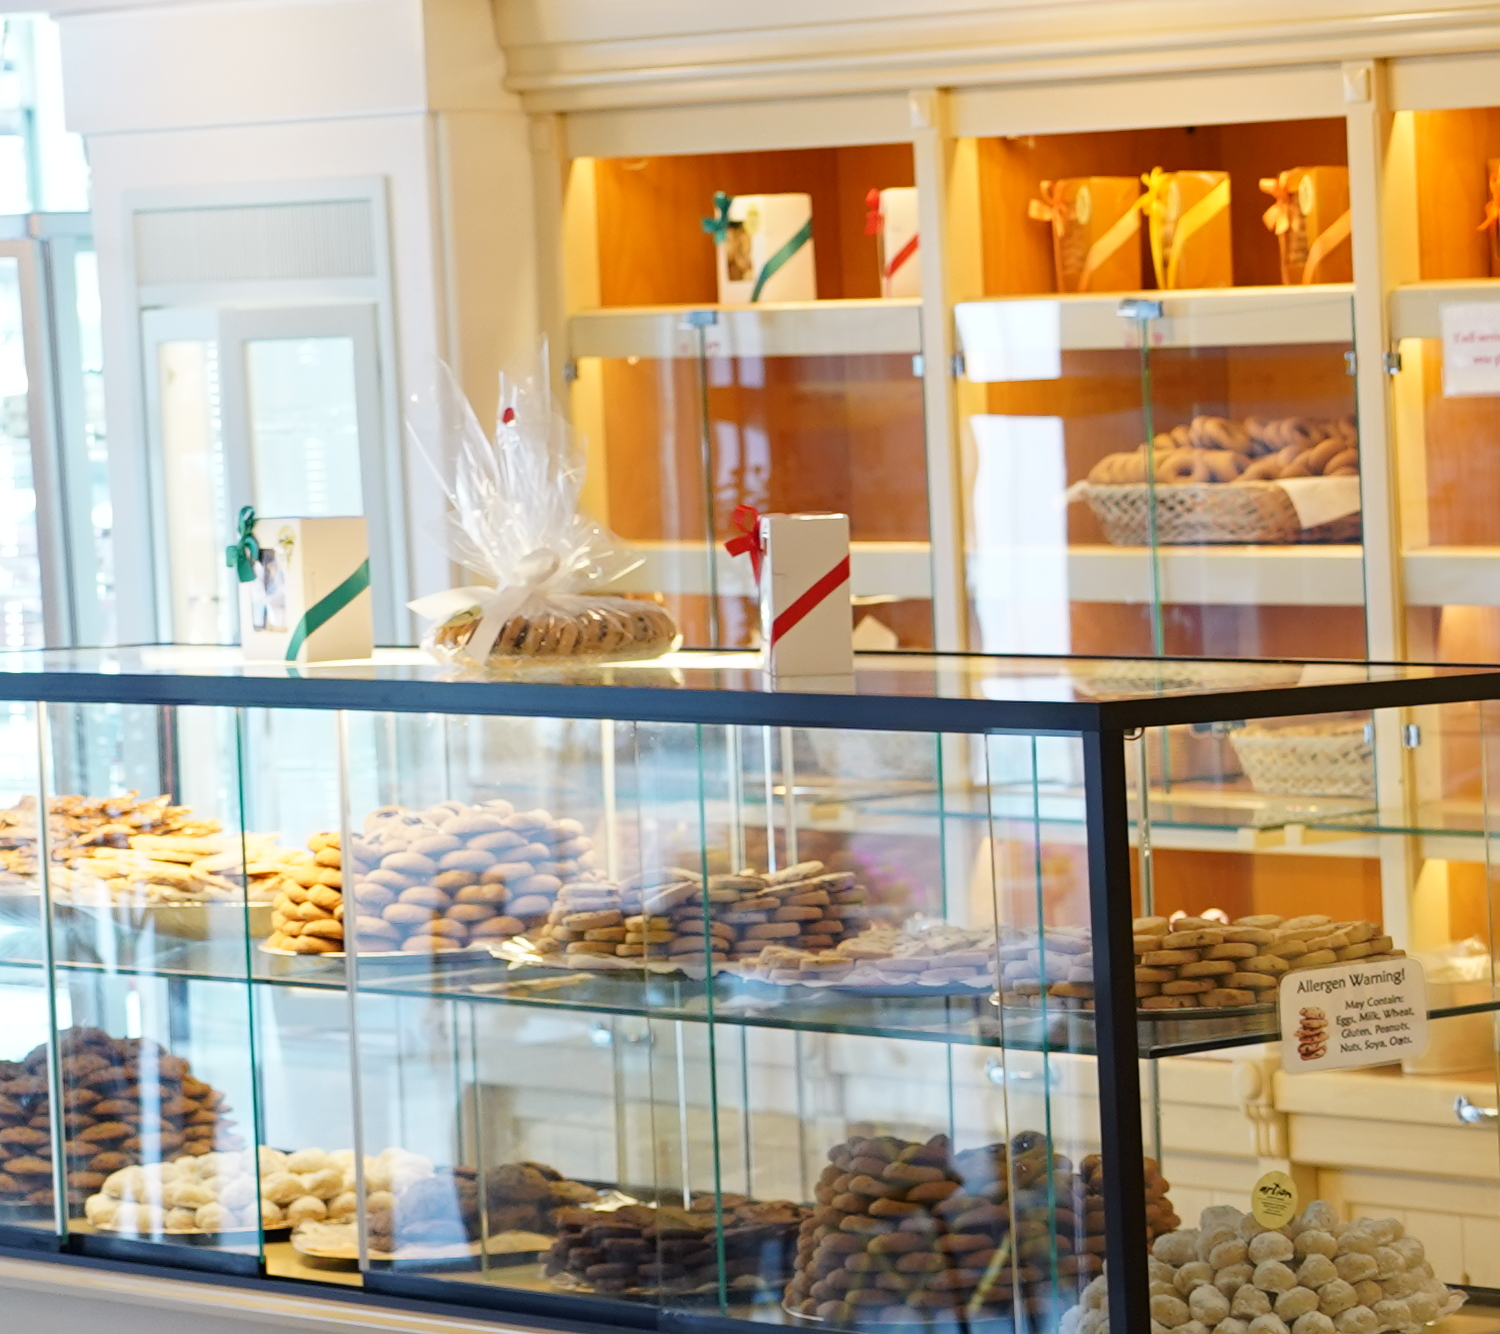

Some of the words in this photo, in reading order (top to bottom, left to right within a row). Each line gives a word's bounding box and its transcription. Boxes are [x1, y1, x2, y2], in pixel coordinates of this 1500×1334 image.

[1297, 979, 1346, 994] Allergen
[1349, 968, 1406, 986] Warning!
[1345, 1000, 1365, 1010] May
